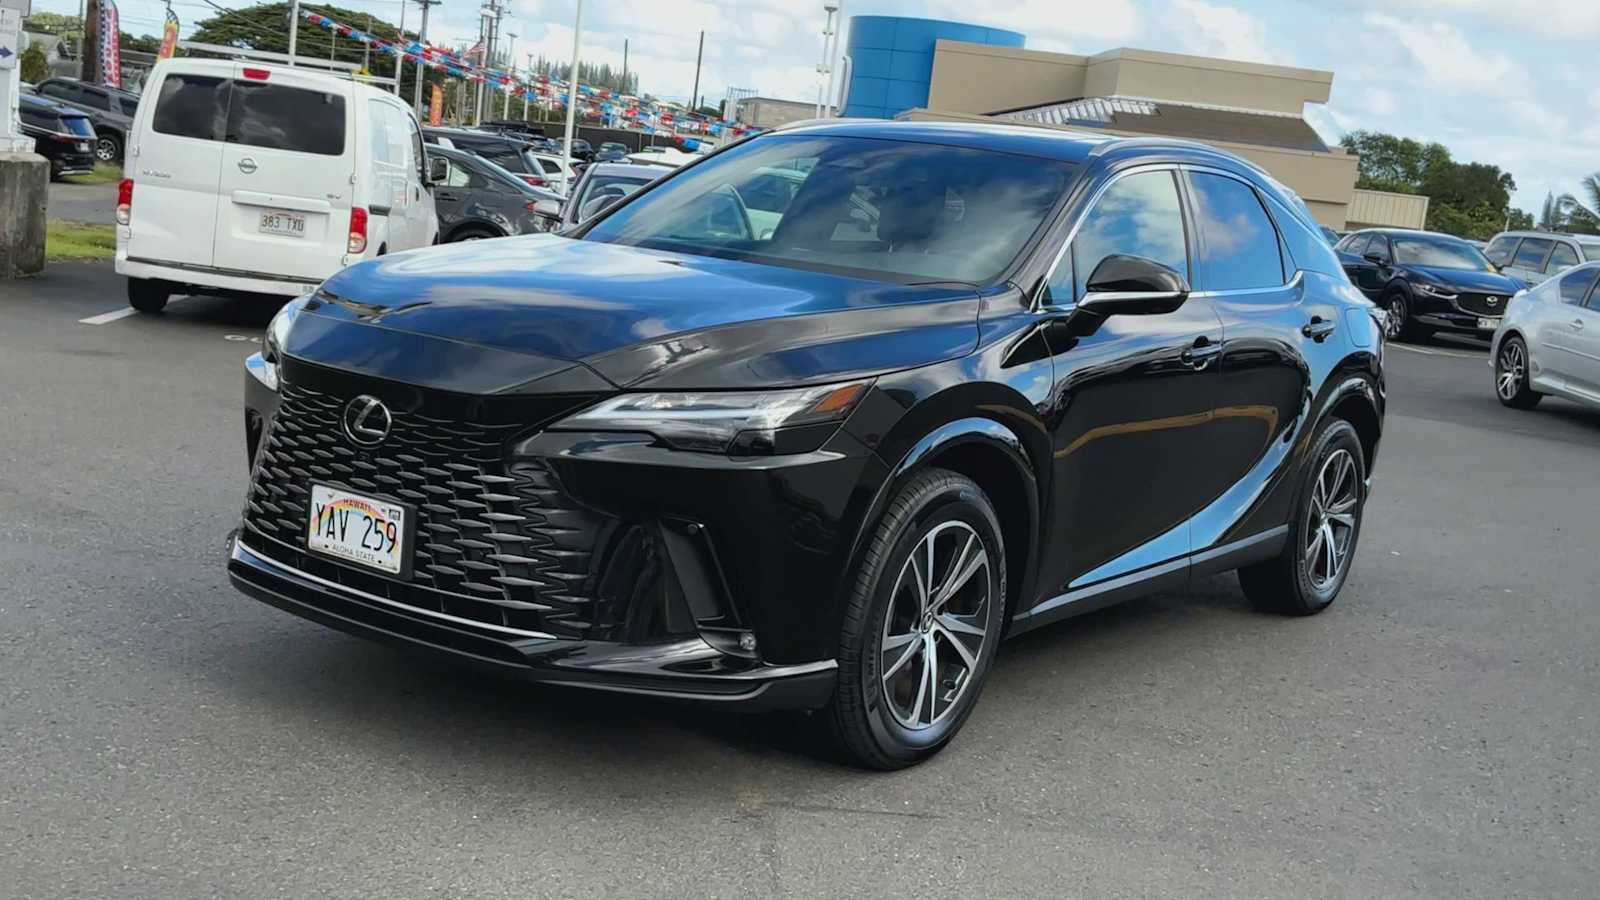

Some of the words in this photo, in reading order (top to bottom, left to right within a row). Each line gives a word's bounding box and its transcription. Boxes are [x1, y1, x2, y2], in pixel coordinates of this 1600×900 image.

[262, 215, 280, 228] 383
[317, 504, 349, 542] YAV
[361, 516, 396, 553] 259
[332, 543, 353, 554] ALOHA
[355, 550, 375, 561] STATE
